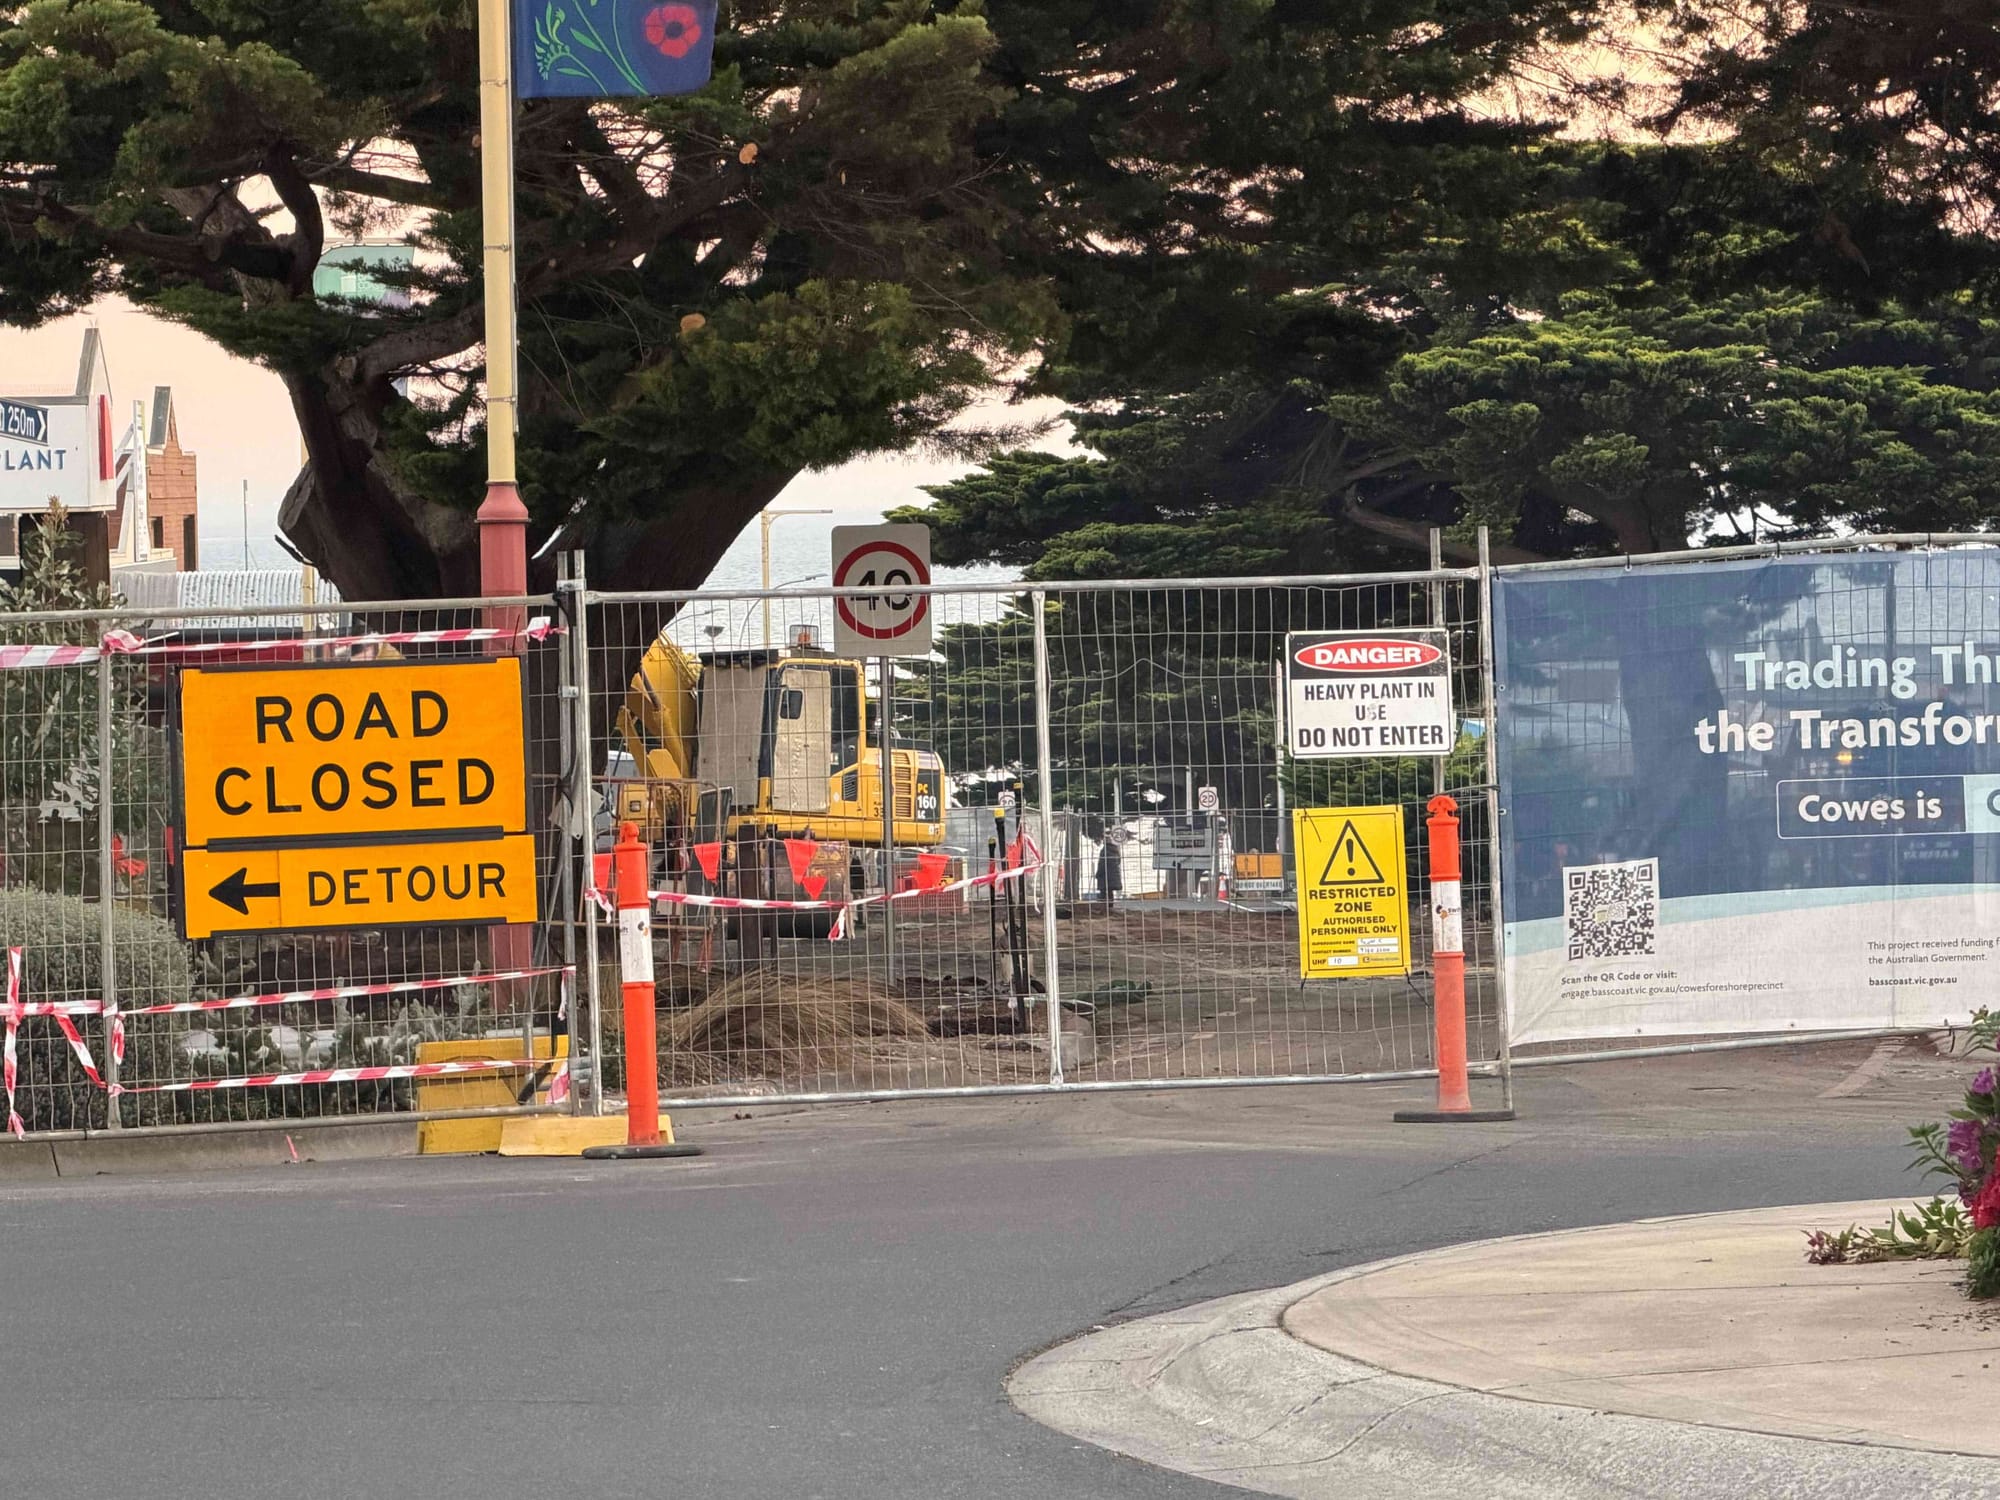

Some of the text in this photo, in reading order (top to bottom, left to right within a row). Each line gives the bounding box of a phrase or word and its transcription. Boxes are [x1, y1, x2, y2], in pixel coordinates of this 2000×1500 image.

[8, 406, 35, 437] 250m
[0, 449, 67, 470] LANT
[851, 568, 913, 611] 40
[1314, 647, 1422, 665] DANGER
[1734, 641, 2000, 699] Trading Th
[1304, 682, 1435, 701] HEAVY PLANT IN
[255, 690, 449, 744] ROAD
[1299, 725, 1444, 748] DO NOT ENTER
[1694, 702, 2000, 754] the Transfor
[214, 758, 495, 815] CLOSED
[917, 783, 928, 794] PC
[917, 795, 937, 809] 160
[1202, 795, 1214, 803] 20
[1798, 790, 1942, 823] Cowes is
[308, 862, 506, 907] DETOUR
[1309, 887, 1396, 900] RESTRICTED
[1334, 902, 1372, 913] ZONE
[1323, 916, 1386, 925] AUTHORISED
[1311, 925, 1398, 936] PERSONNEL ONLY
[1867, 941, 1886, 950] This
[1888, 940, 1919, 951] project
[1922, 938, 1958, 948] received
[1961, 938, 1994, 949] funding
[1868, 953, 1988, 964] the Australian Government.
[1561, 977, 1581, 985] Scan
[1584, 974, 1598, 982] the
[1600, 973, 1615, 982] QR
[1617, 972, 1640, 980] Code
[1656, 970, 1678, 979] visit:
[1869, 976, 1958, 986] basscoast.vic.gov.au
[1561, 982, 1784, 1000] engage.basscoast.vic.gov.au/cowesforeshoreprecinct
